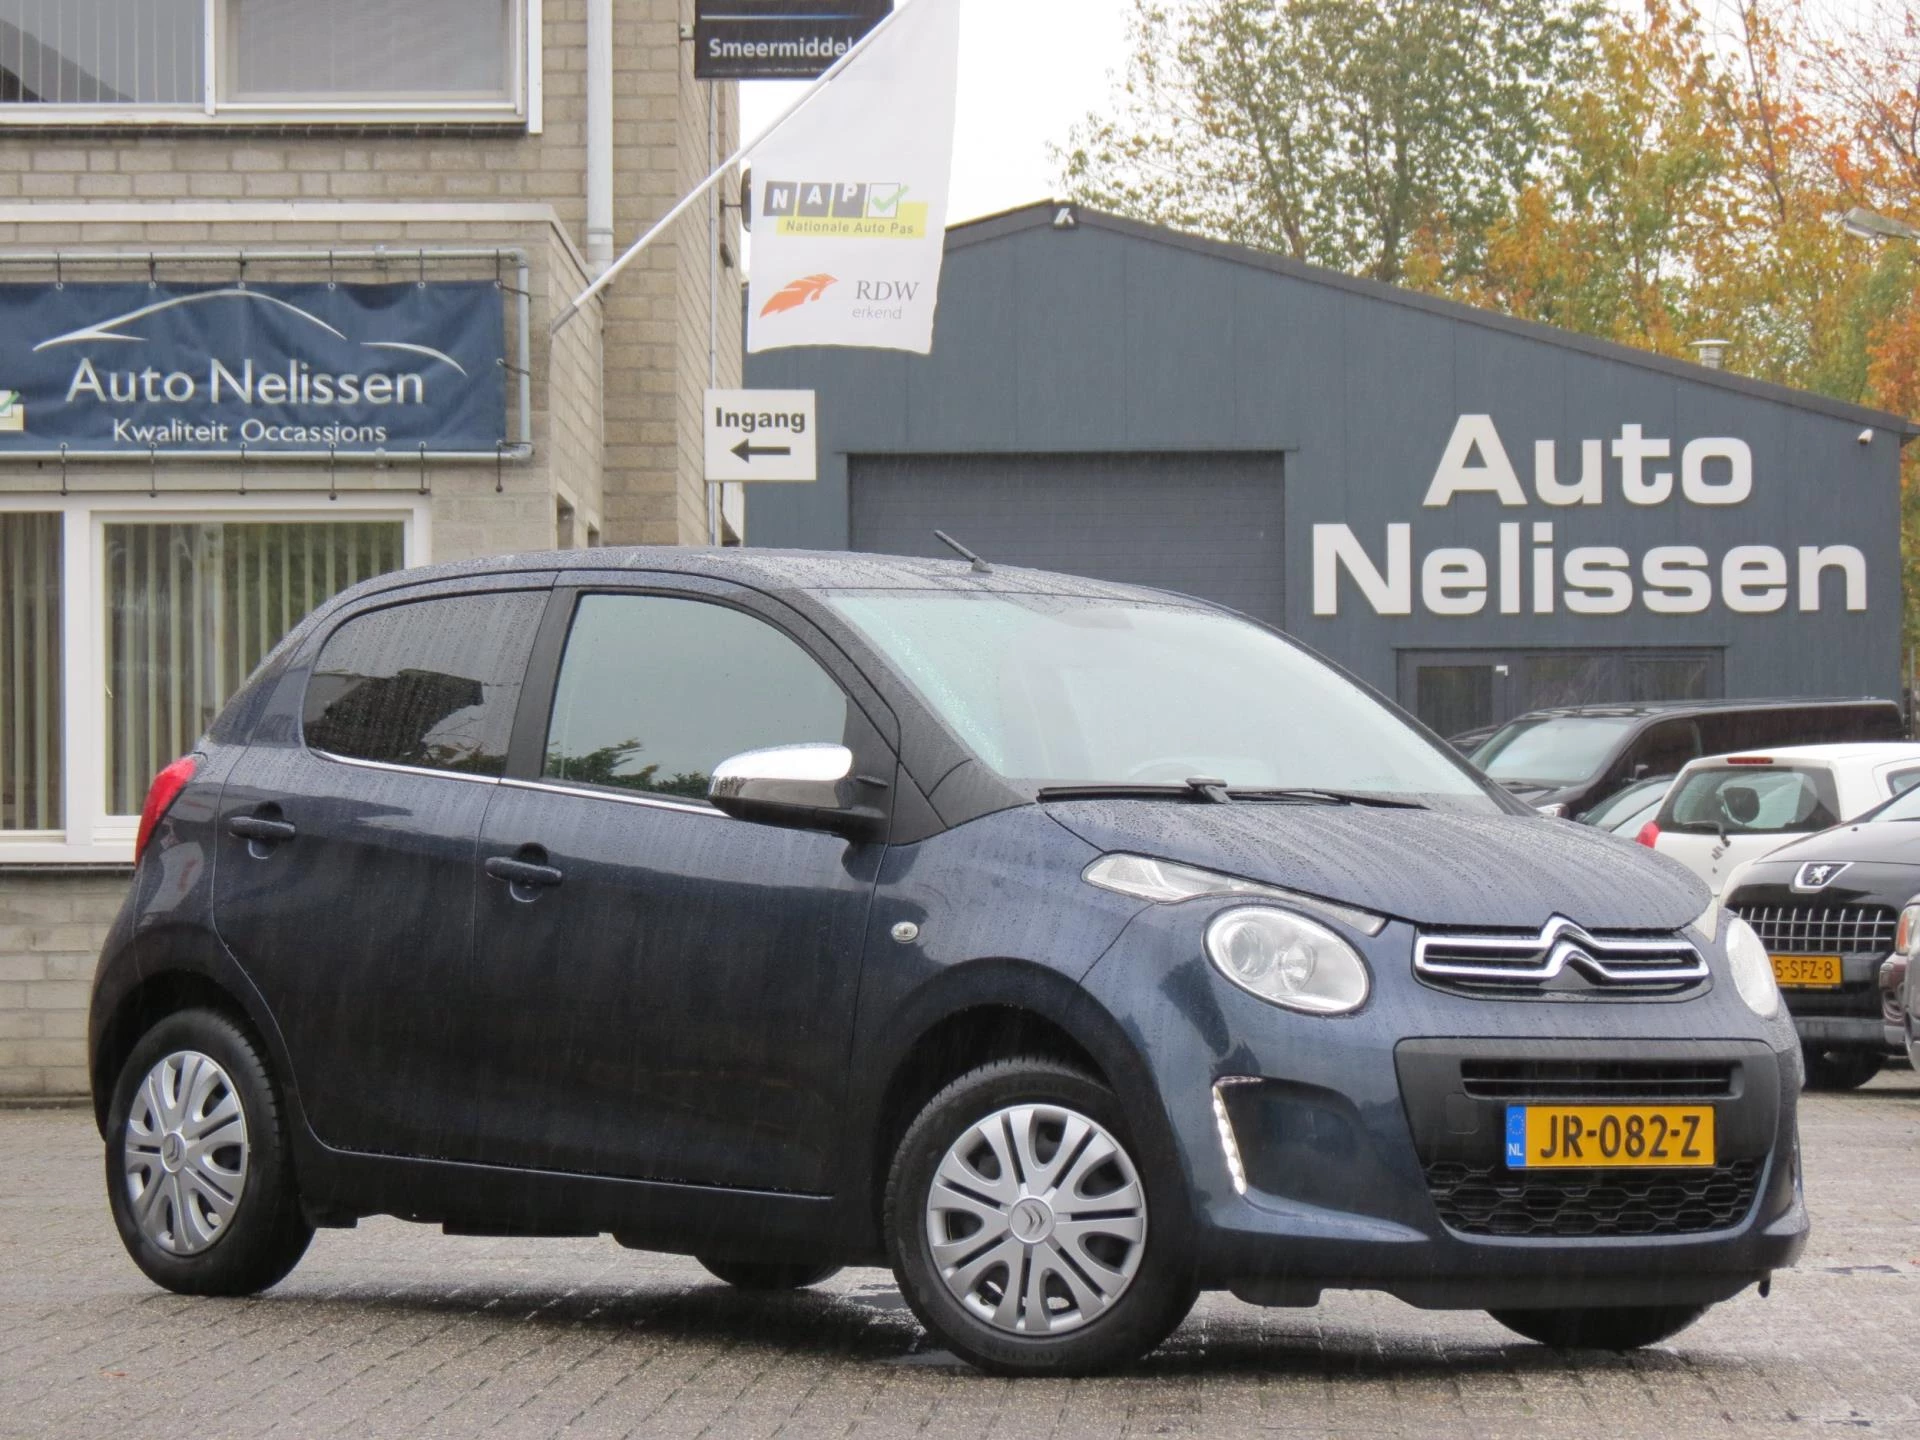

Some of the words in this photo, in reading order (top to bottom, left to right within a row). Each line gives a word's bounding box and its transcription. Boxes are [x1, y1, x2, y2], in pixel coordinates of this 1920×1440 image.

[786, 219, 850, 233] Nationale
[853, 223, 885, 234] Auto
[890, 222, 914, 235] Pas
[856, 279, 920, 301] RDW
[852, 306, 902, 320] erkend
[66, 357, 195, 403] Auto
[210, 359, 425, 404] Nelissen
[113, 418, 228, 443] Kwaliteit
[241, 418, 387, 444] Occassions
[715, 407, 806, 433] Ingang
[1422, 414, 1753, 507] Auto
[1312, 522, 1867, 616] Nelissen
[1540, 1114, 1700, 1159] JR-082-Z
[1508, 1143, 1523, 1157] NL
